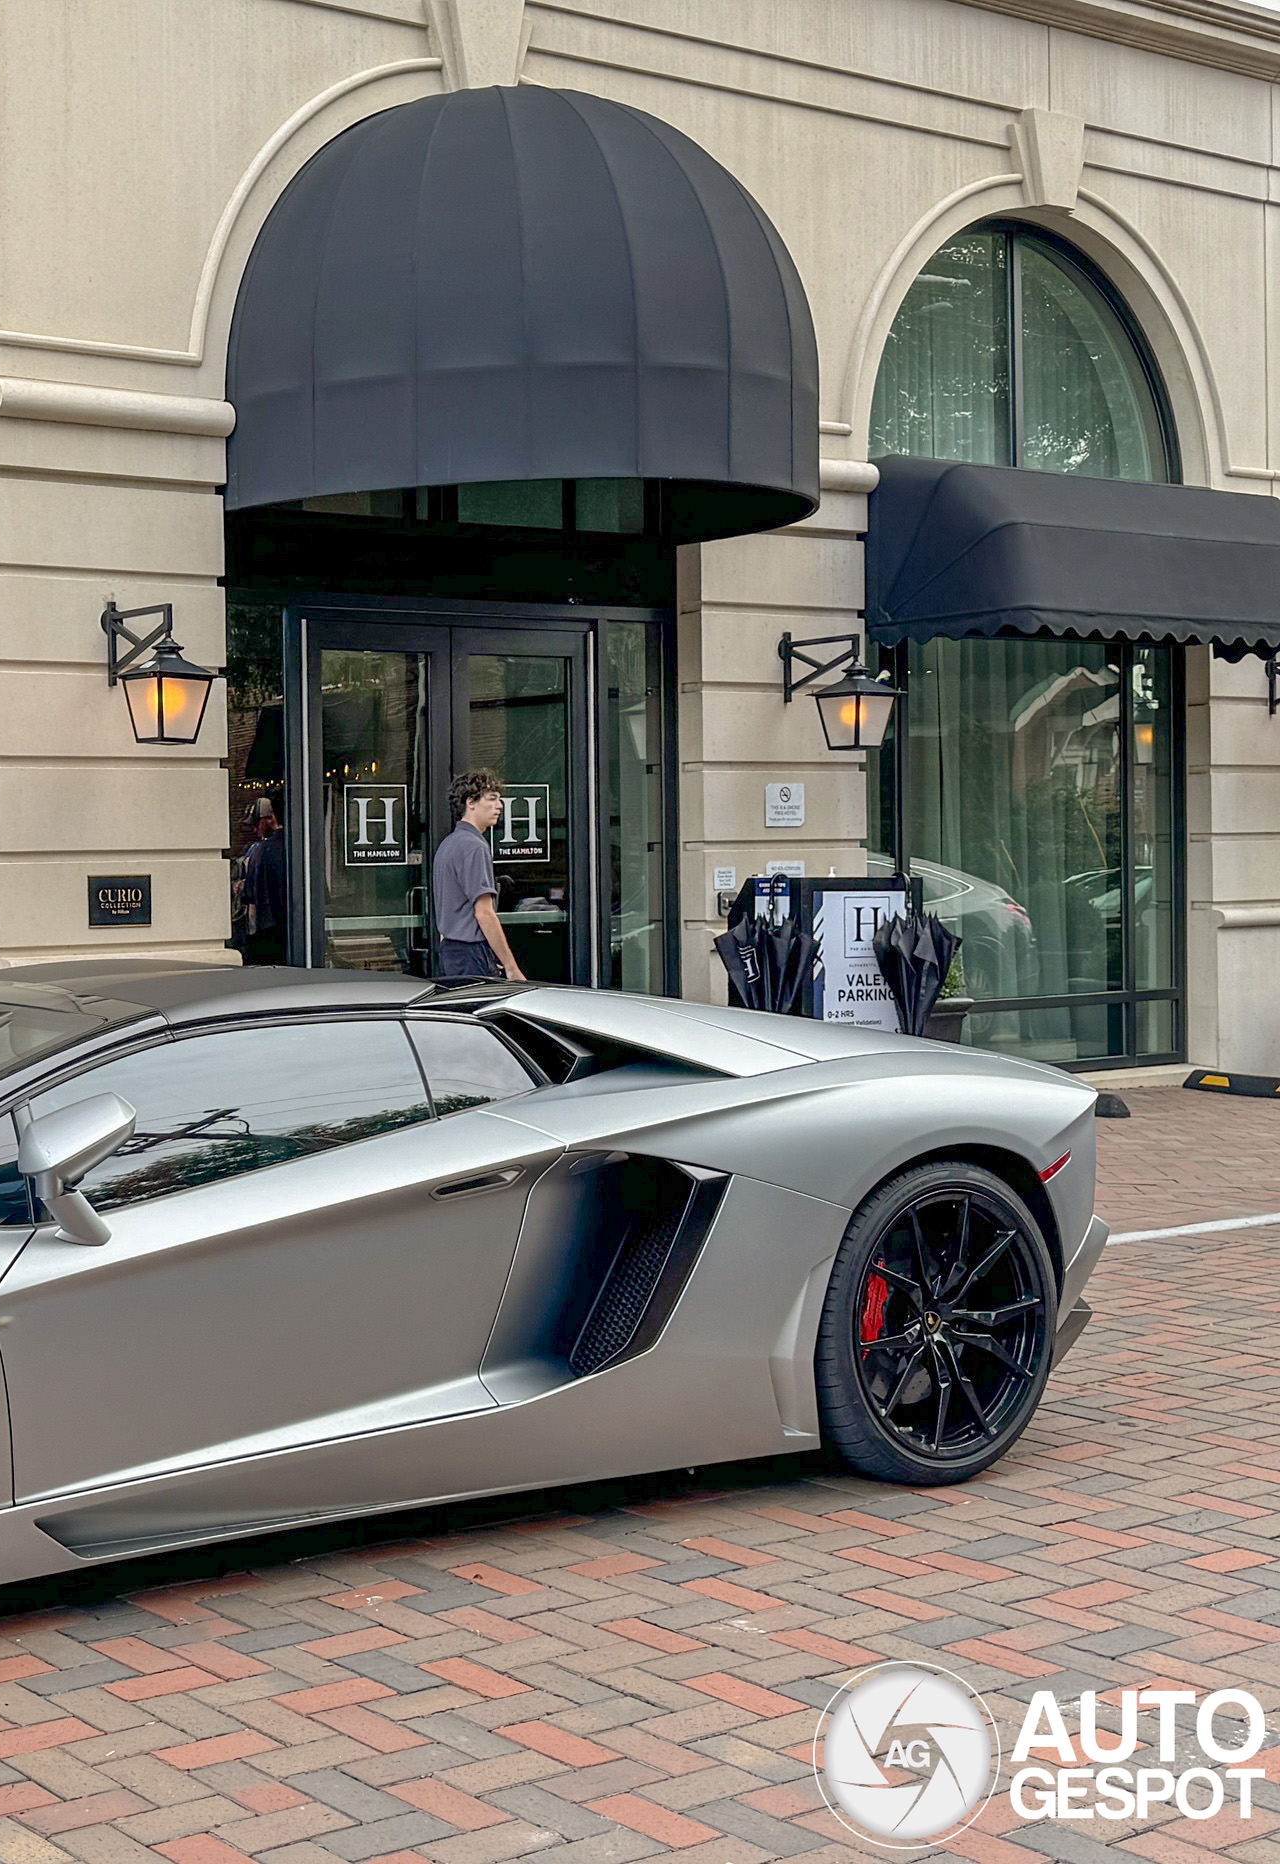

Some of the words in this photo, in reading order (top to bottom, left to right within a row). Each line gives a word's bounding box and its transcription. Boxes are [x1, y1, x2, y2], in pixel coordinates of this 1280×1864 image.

[353, 797, 400, 845] H
[499, 797, 542, 842] H
[353, 850, 365, 858] THE
[367, 850, 400, 858] HAMILTON
[512, 847, 543, 855] HAMILTON
[99, 888, 143, 902] CURIO
[853, 906, 882, 942] H
